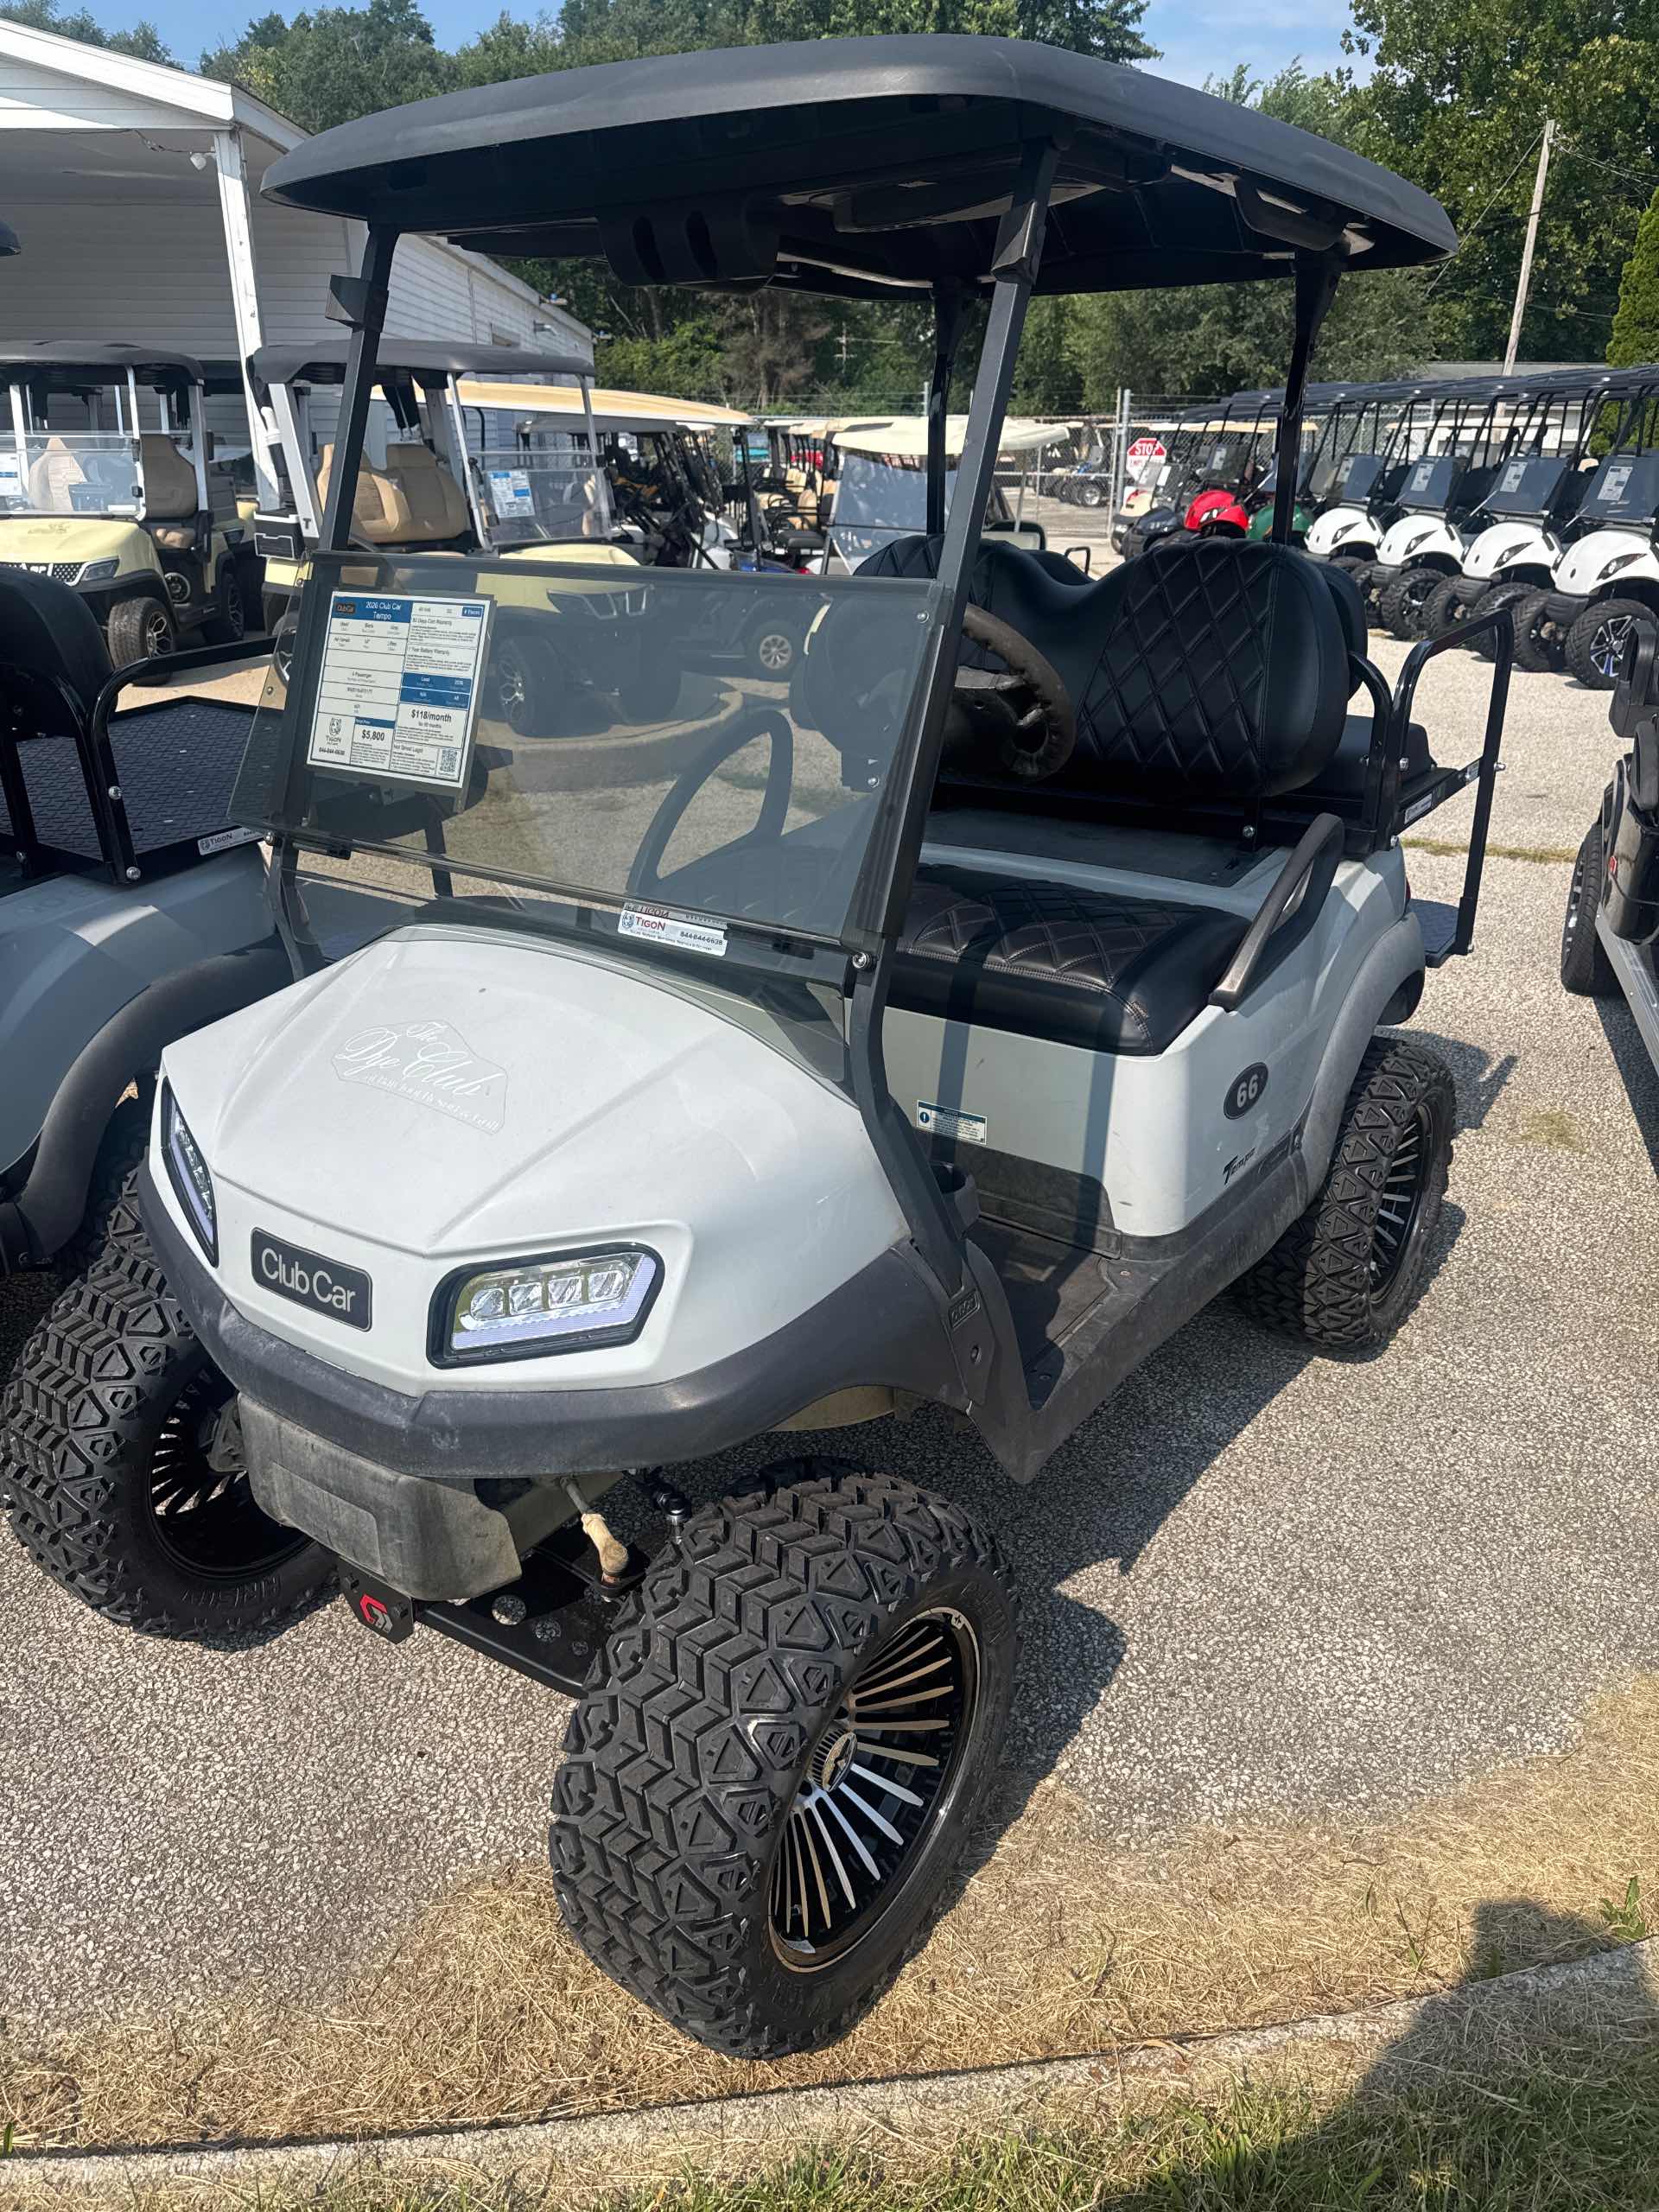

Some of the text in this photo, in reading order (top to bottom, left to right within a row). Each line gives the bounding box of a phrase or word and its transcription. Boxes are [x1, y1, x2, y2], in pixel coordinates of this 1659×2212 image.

[373, 611, 392, 620] Tempo
[411, 709, 452, 722] $118/month
[361, 729, 385, 741] $5,800
[211, 832, 233, 845] TIGON
[635, 916, 665, 931] TIGON
[1236, 1074, 1259, 1109] 66
